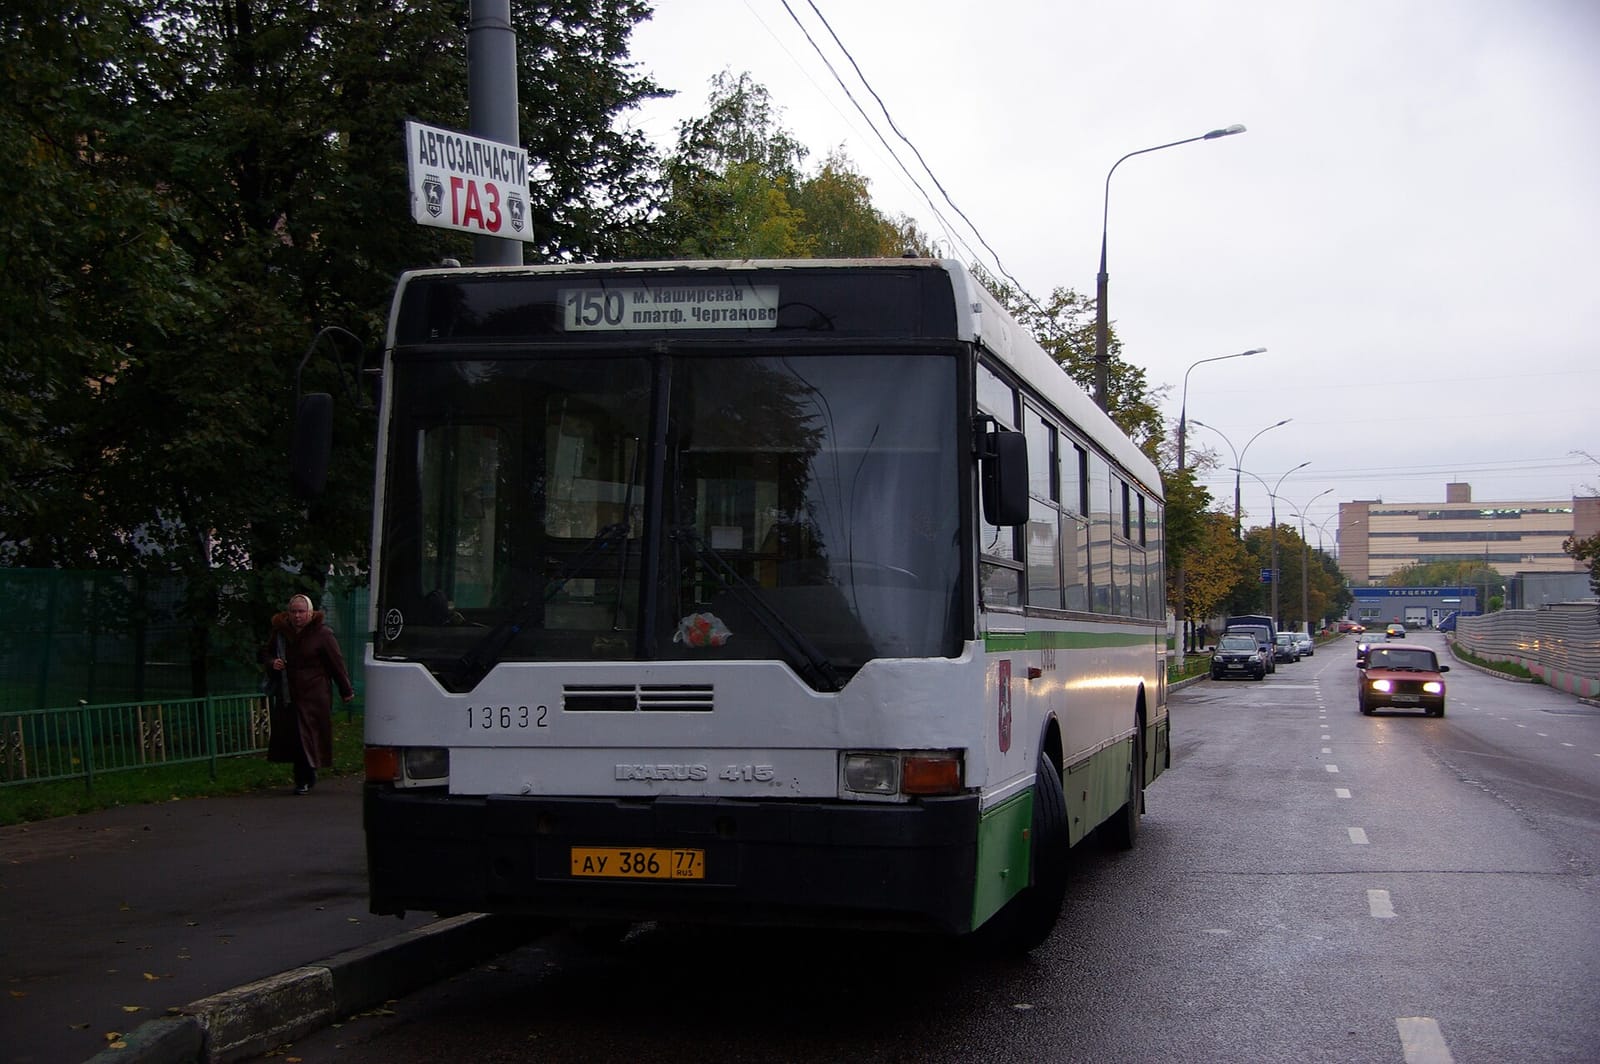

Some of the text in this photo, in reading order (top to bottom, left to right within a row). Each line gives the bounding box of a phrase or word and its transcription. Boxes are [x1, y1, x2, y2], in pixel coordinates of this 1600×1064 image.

[419, 129, 526, 187] АВТОЗАПЧАСТИ
[450, 176, 502, 233] ГАЗ
[632, 288, 744, 304] м. Каширская
[567, 290, 625, 326] 150
[632, 307, 777, 324] платф. Чертаново
[467, 706, 548, 729] 13632
[615, 764, 774, 781] IKARUS 415
[619, 852, 660, 874] 386
[674, 852, 696, 870] 77
